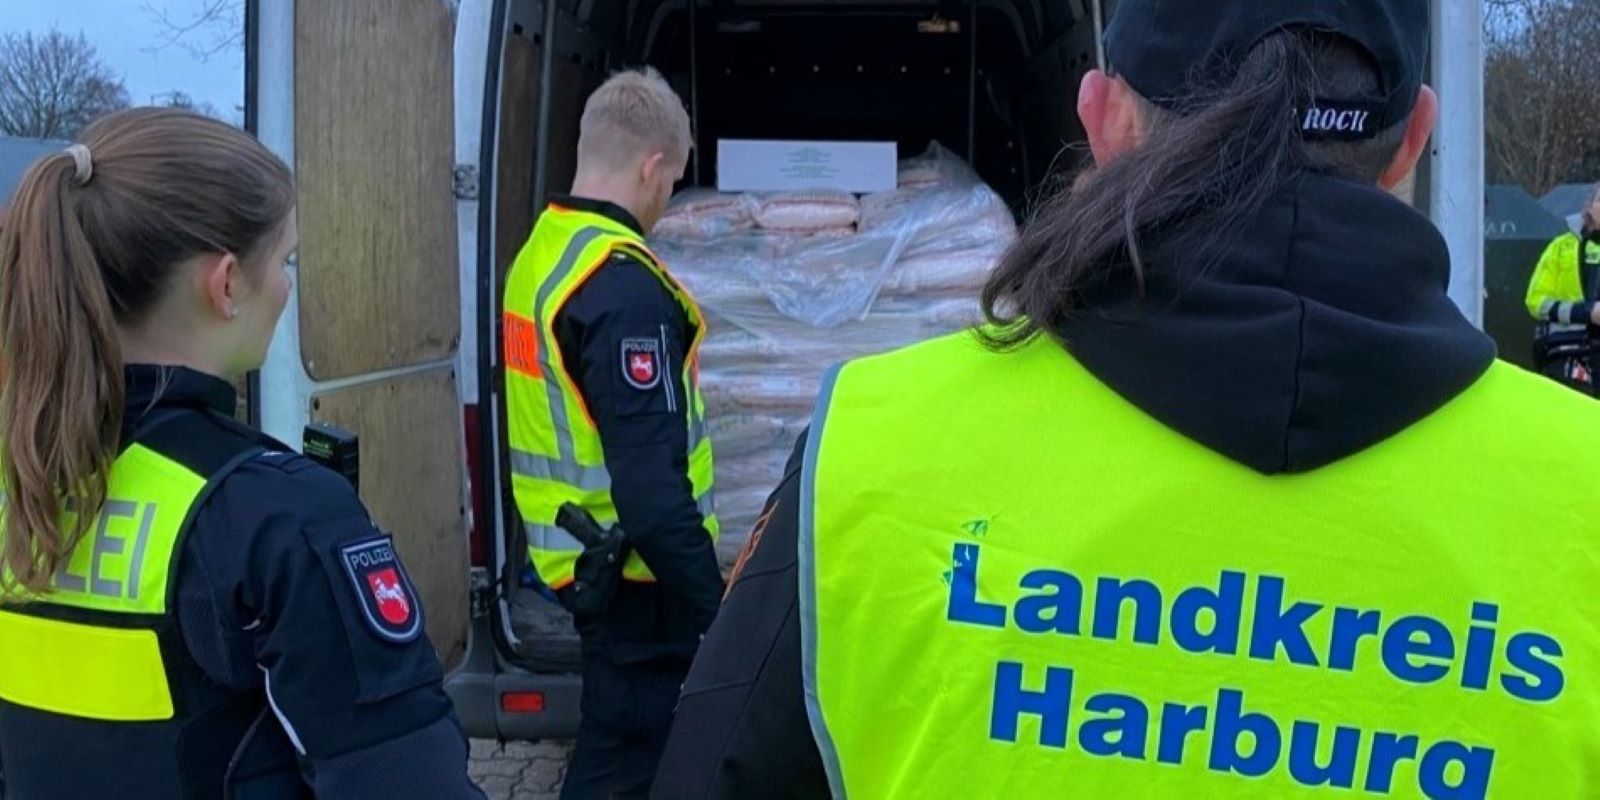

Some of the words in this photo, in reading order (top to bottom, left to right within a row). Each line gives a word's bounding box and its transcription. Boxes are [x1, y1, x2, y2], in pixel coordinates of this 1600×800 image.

[1303, 108, 1369, 132] ROCK
[947, 542, 1565, 703] Landkreis
[990, 660, 1496, 800] Harburg
